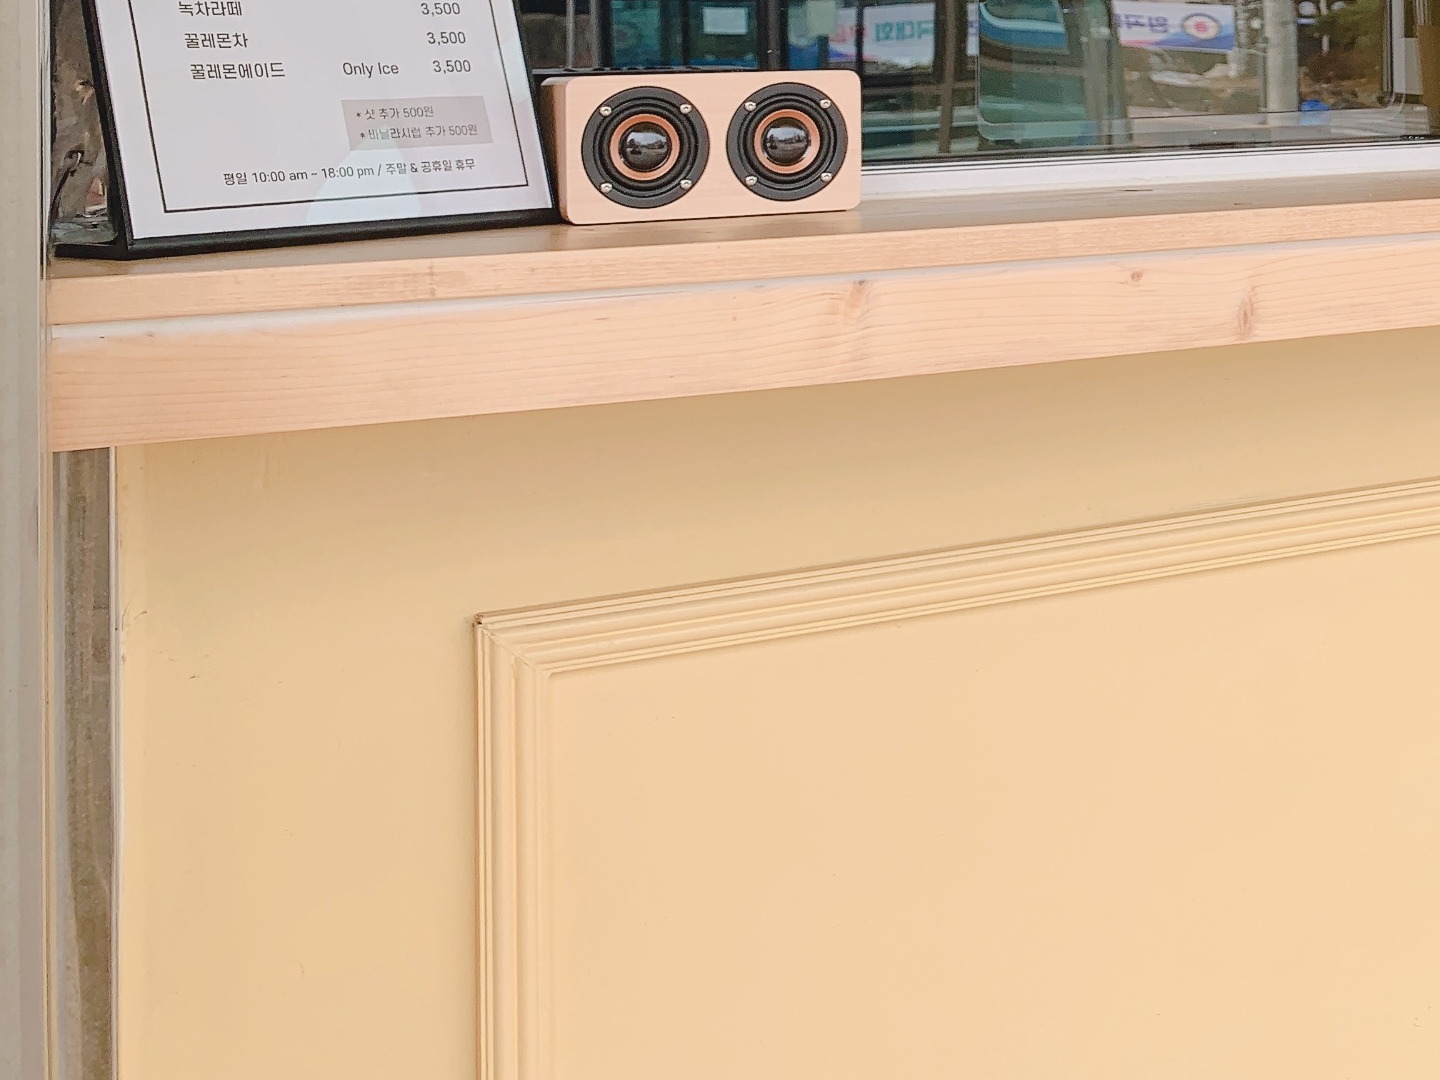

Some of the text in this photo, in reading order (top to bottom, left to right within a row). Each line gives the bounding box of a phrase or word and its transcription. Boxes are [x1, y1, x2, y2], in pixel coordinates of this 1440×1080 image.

[178, 0, 461, 17] 녹차라떼 3,500
[184, 31, 466, 49] 꿀레몬차 3,500
[190, 59, 471, 80] 꿀레몬에이드 Only Ice 3,500
[378, 107, 400, 120] 추가
[402, 105, 435, 119] 500원
[368, 123, 479, 140] 바닐라시럽 추가 500원
[223, 172, 248, 186] 평일
[251, 170, 286, 183] 10:00
[289, 170, 308, 181] am
[321, 166, 354, 179] 18:00
[356, 167, 375, 179] pm
[385, 162, 407, 175] 주말
[410, 162, 419, 173] &
[420, 159, 453, 174] 공휴일
[455, 158, 476, 171] 휴무
